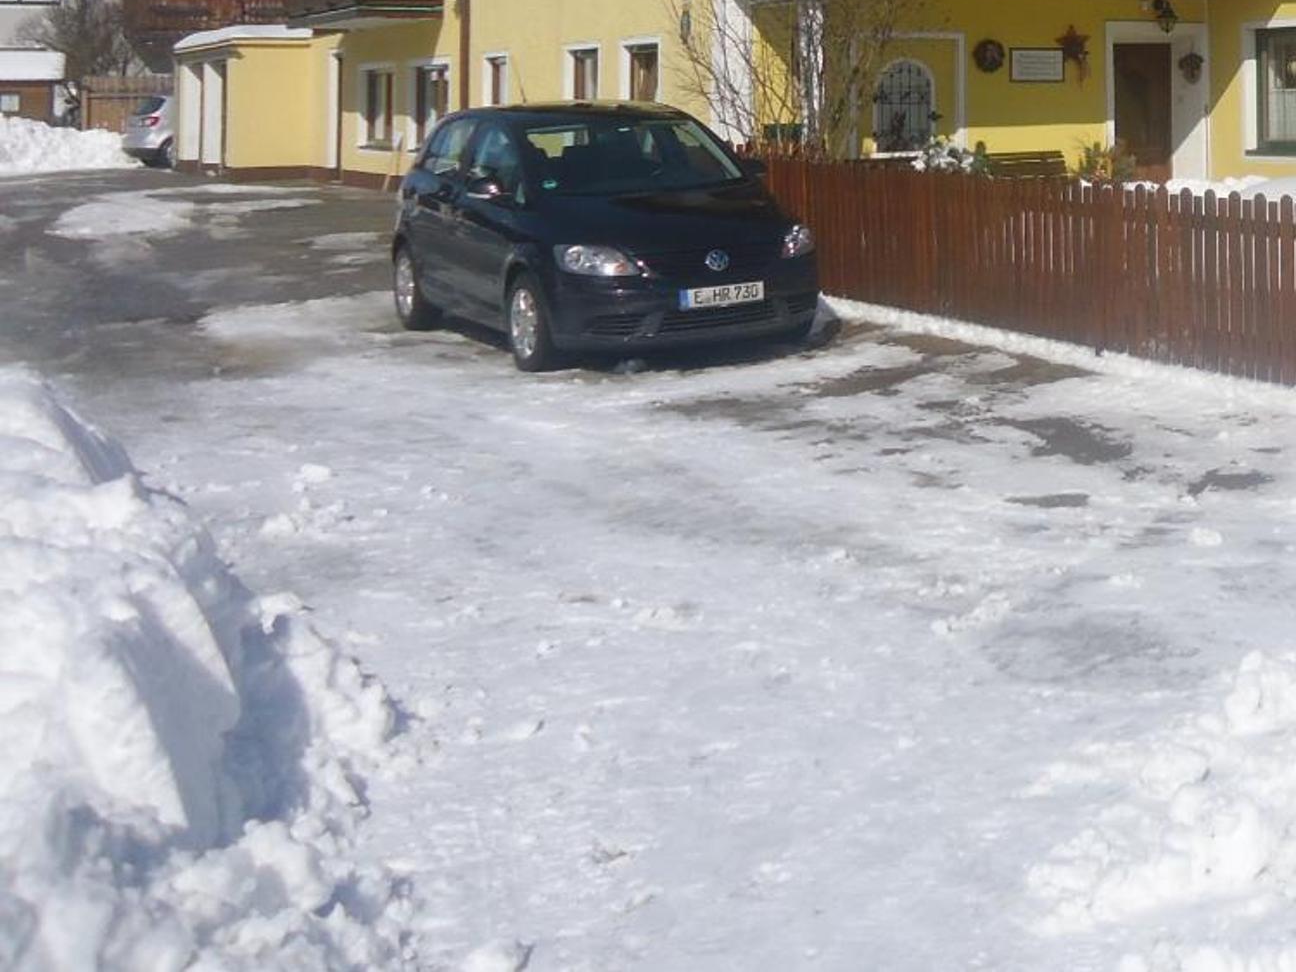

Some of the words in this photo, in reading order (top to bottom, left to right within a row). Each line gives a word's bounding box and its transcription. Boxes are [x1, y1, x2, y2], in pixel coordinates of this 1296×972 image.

[694, 291, 703, 304] E
[713, 287, 731, 302] HR
[734, 283, 758, 300] 730
